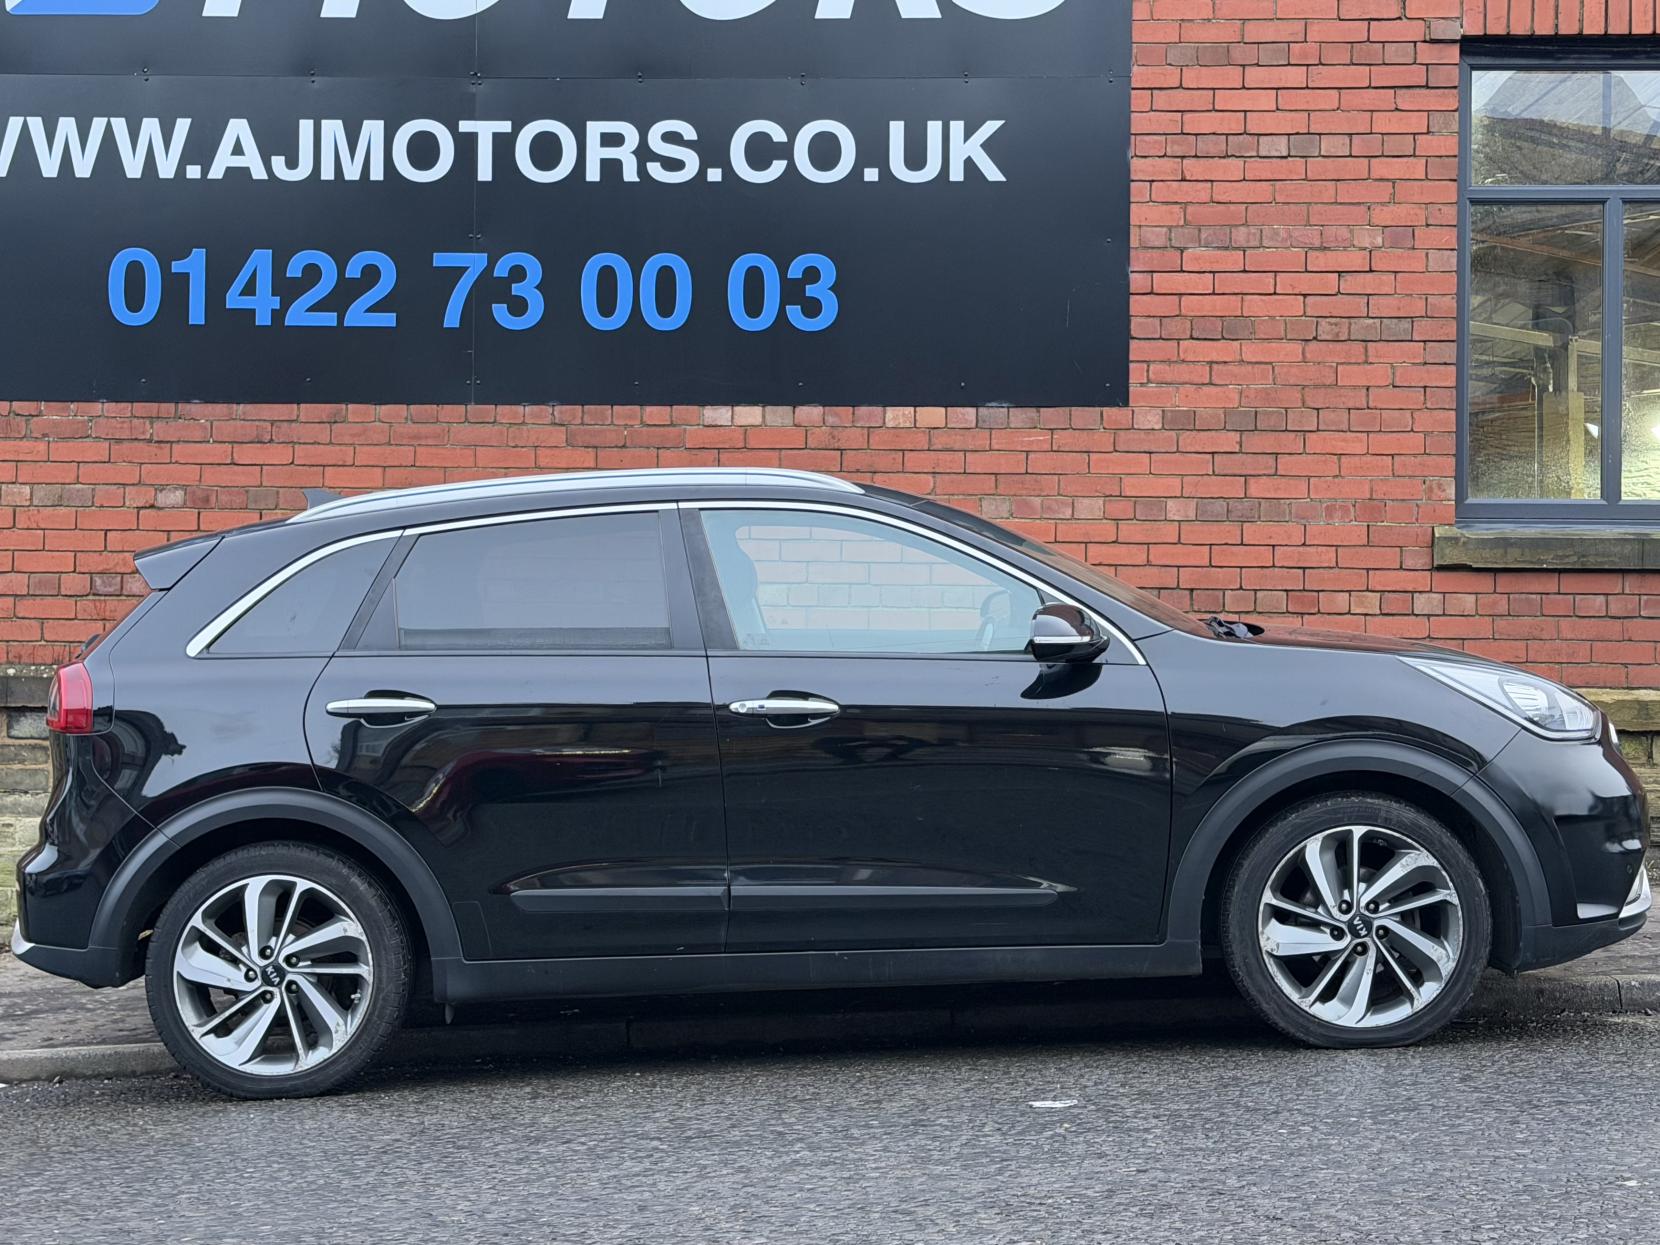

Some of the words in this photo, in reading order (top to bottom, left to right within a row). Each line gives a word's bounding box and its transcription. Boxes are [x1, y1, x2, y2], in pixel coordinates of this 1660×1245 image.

[0, 116, 1007, 184] WW.AJMOTORS.CO.UK
[107, 247, 397, 328] 01422
[432, 252, 545, 331] 73
[580, 252, 693, 331] 00
[727, 252, 839, 332] 03
[1353, 916, 1368, 937] KIA
[265, 965, 281, 986] KIA
